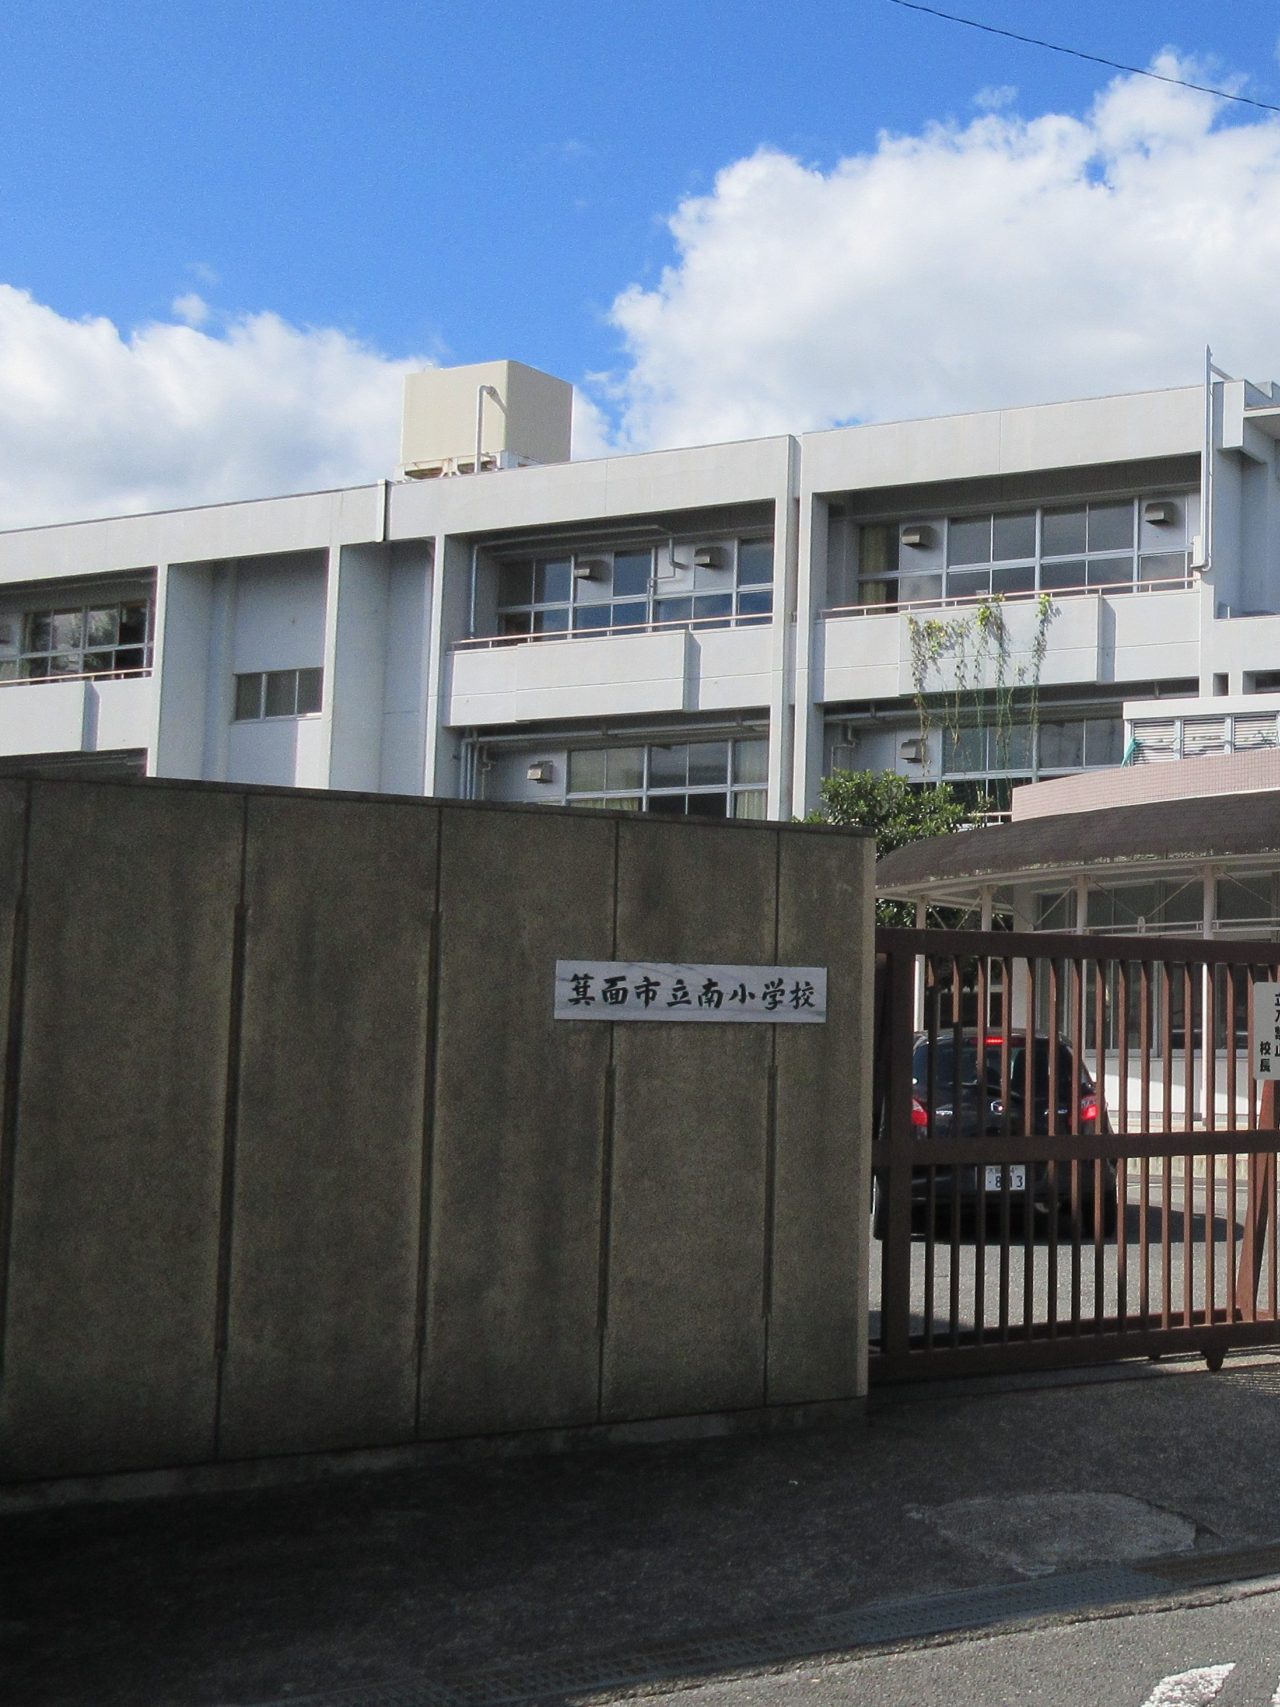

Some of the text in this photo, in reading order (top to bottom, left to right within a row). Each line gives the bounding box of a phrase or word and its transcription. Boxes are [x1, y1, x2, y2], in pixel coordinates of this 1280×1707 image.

[567, 973, 816, 1011] 箕面市立南小学校
[1260, 1041, 1271, 1073] 校長
